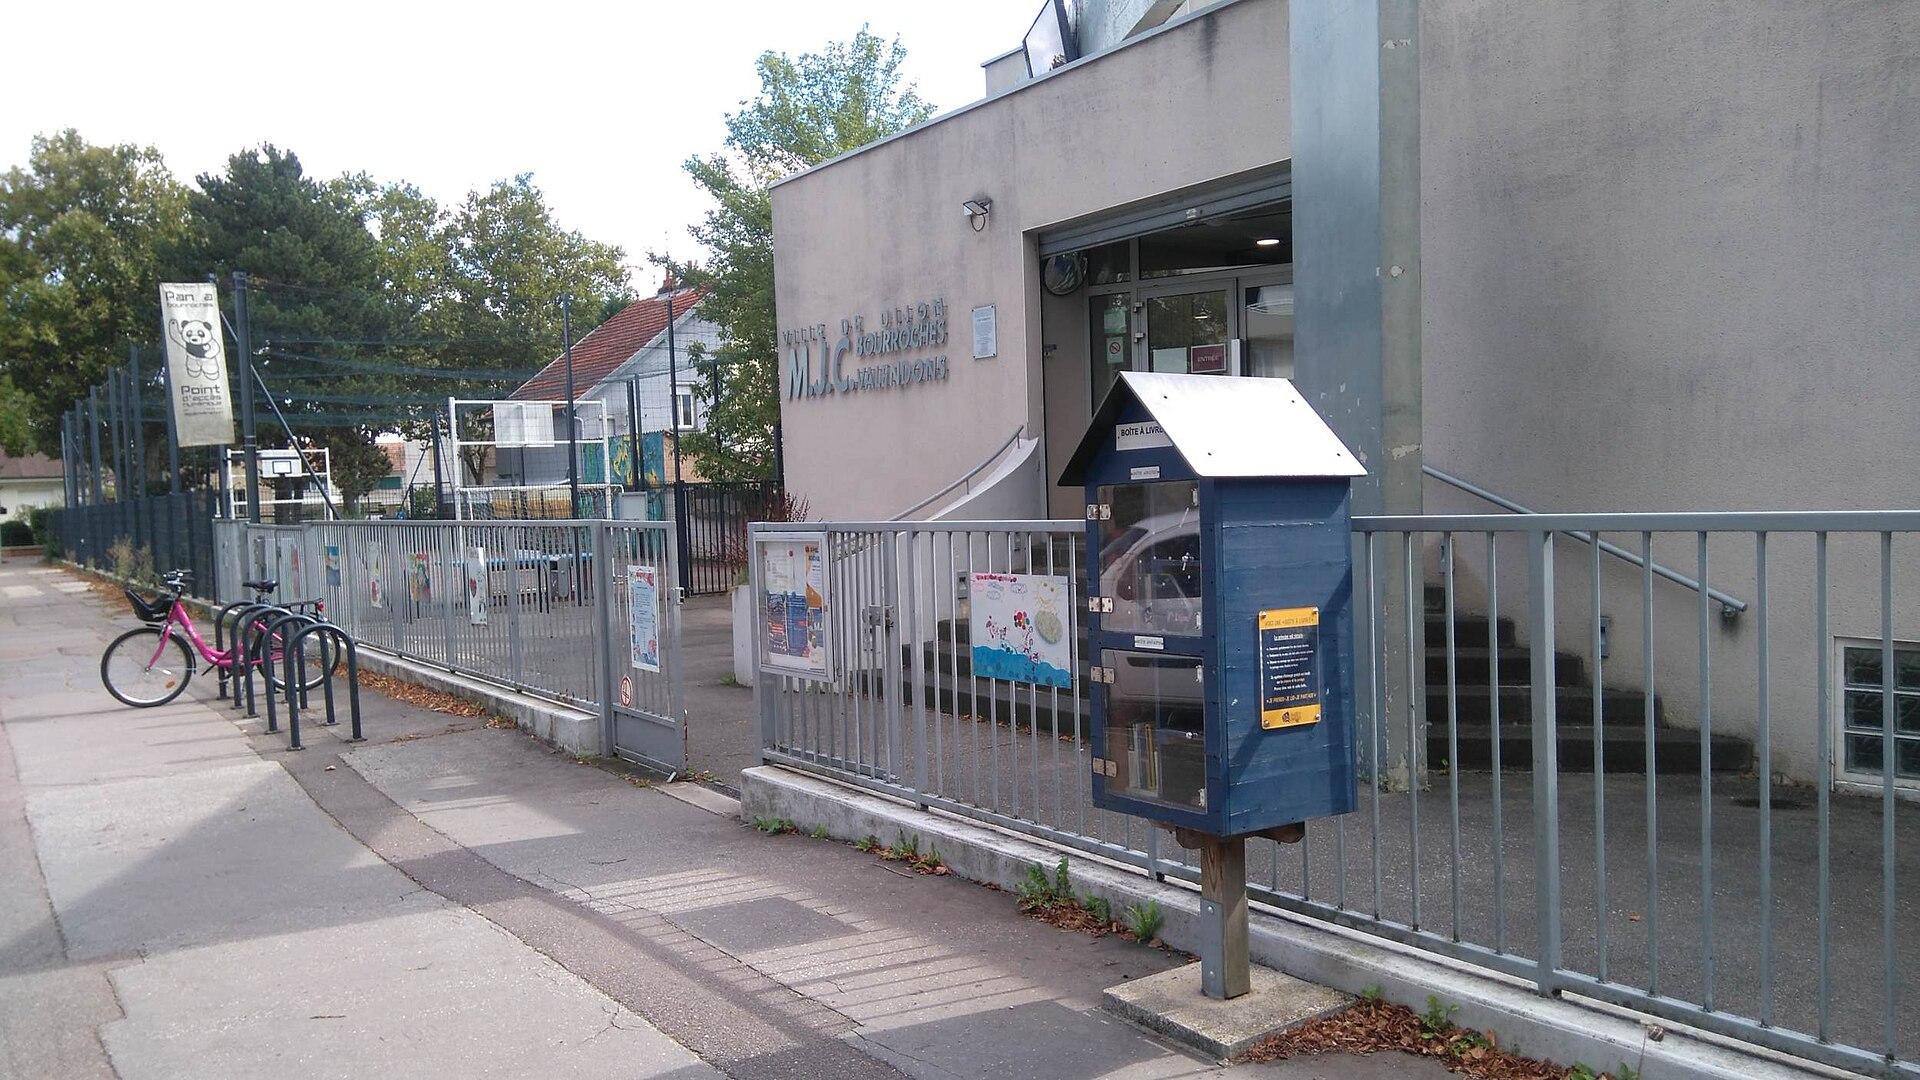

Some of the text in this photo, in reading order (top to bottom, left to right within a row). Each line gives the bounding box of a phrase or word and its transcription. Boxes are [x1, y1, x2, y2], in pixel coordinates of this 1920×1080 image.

[841, 313, 864, 336] DE
[857, 319, 948, 357] BOURROCHES
[181, 385, 220, 395] Point
[1120, 427, 1138, 436] BOÎTE
